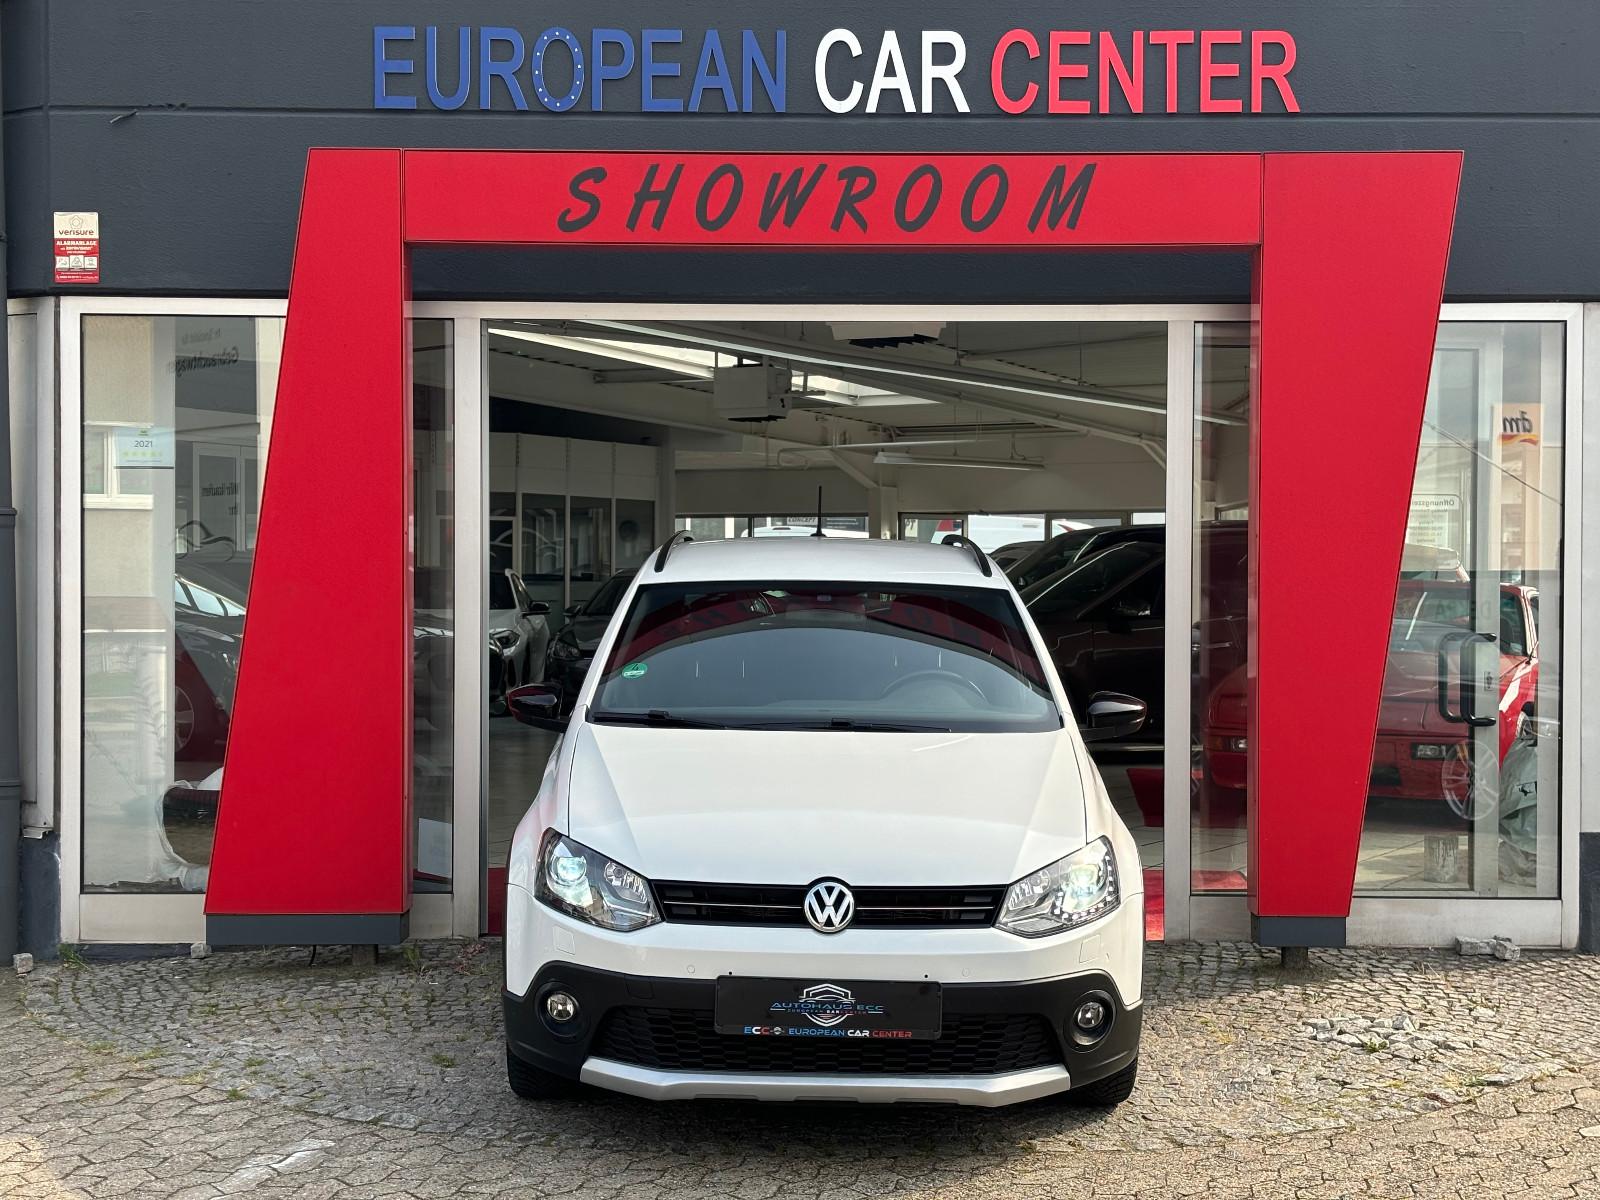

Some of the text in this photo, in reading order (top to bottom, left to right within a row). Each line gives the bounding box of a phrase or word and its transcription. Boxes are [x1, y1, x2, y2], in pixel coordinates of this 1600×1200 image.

[373, 26, 1300, 113] EUROPEAN CAR CENTER
[556, 163, 1097, 233] SHOWROOM
[134, 440, 153, 448] 2021
[771, 1002, 853, 1010] AUTOHAUS
[788, 1027, 845, 1037] EUROPEAN
[847, 1029, 870, 1037] CAR
[872, 1030, 913, 1039] CENTER
